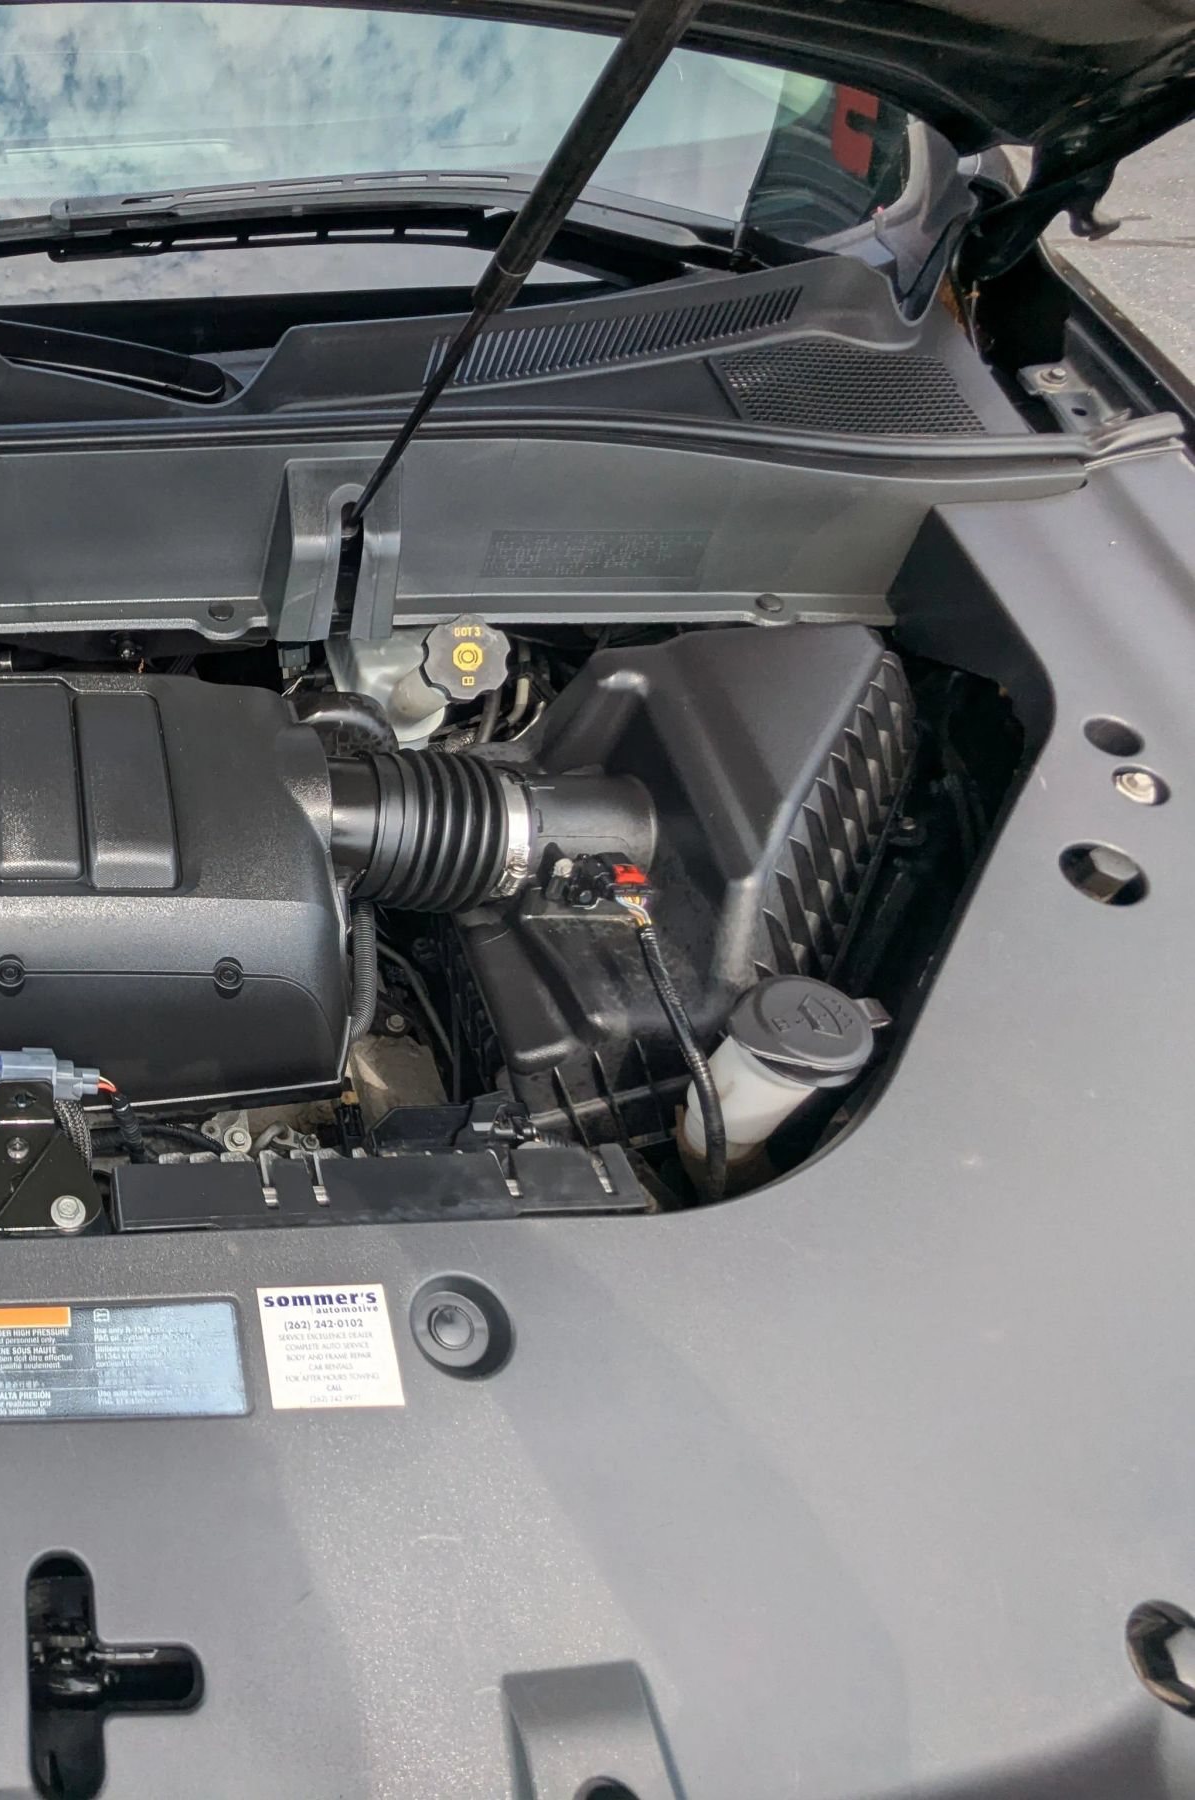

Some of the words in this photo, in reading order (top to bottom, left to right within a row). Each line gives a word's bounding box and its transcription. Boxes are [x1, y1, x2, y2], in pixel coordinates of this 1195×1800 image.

[454, 627, 473, 637] DOT
[474, 626, 481, 636] 3
[263, 1291, 377, 1308] sommer's
[315, 1304, 379, 1314] automotive
[284, 1320, 311, 1332] (262)
[313, 1318, 364, 1329] 242-0102
[12, 1329, 31, 1337] HIGH
[31, 1328, 70, 1337] PRESSURE
[5, 1336, 40, 1345] personnel
[11, 1346, 32, 1354] SOUS
[32, 1345, 57, 1354] HAUTE
[307, 1353, 324, 1362] AND
[326, 1384, 343, 1392] CALL
[0, 1391, 18, 1400] ALTA
